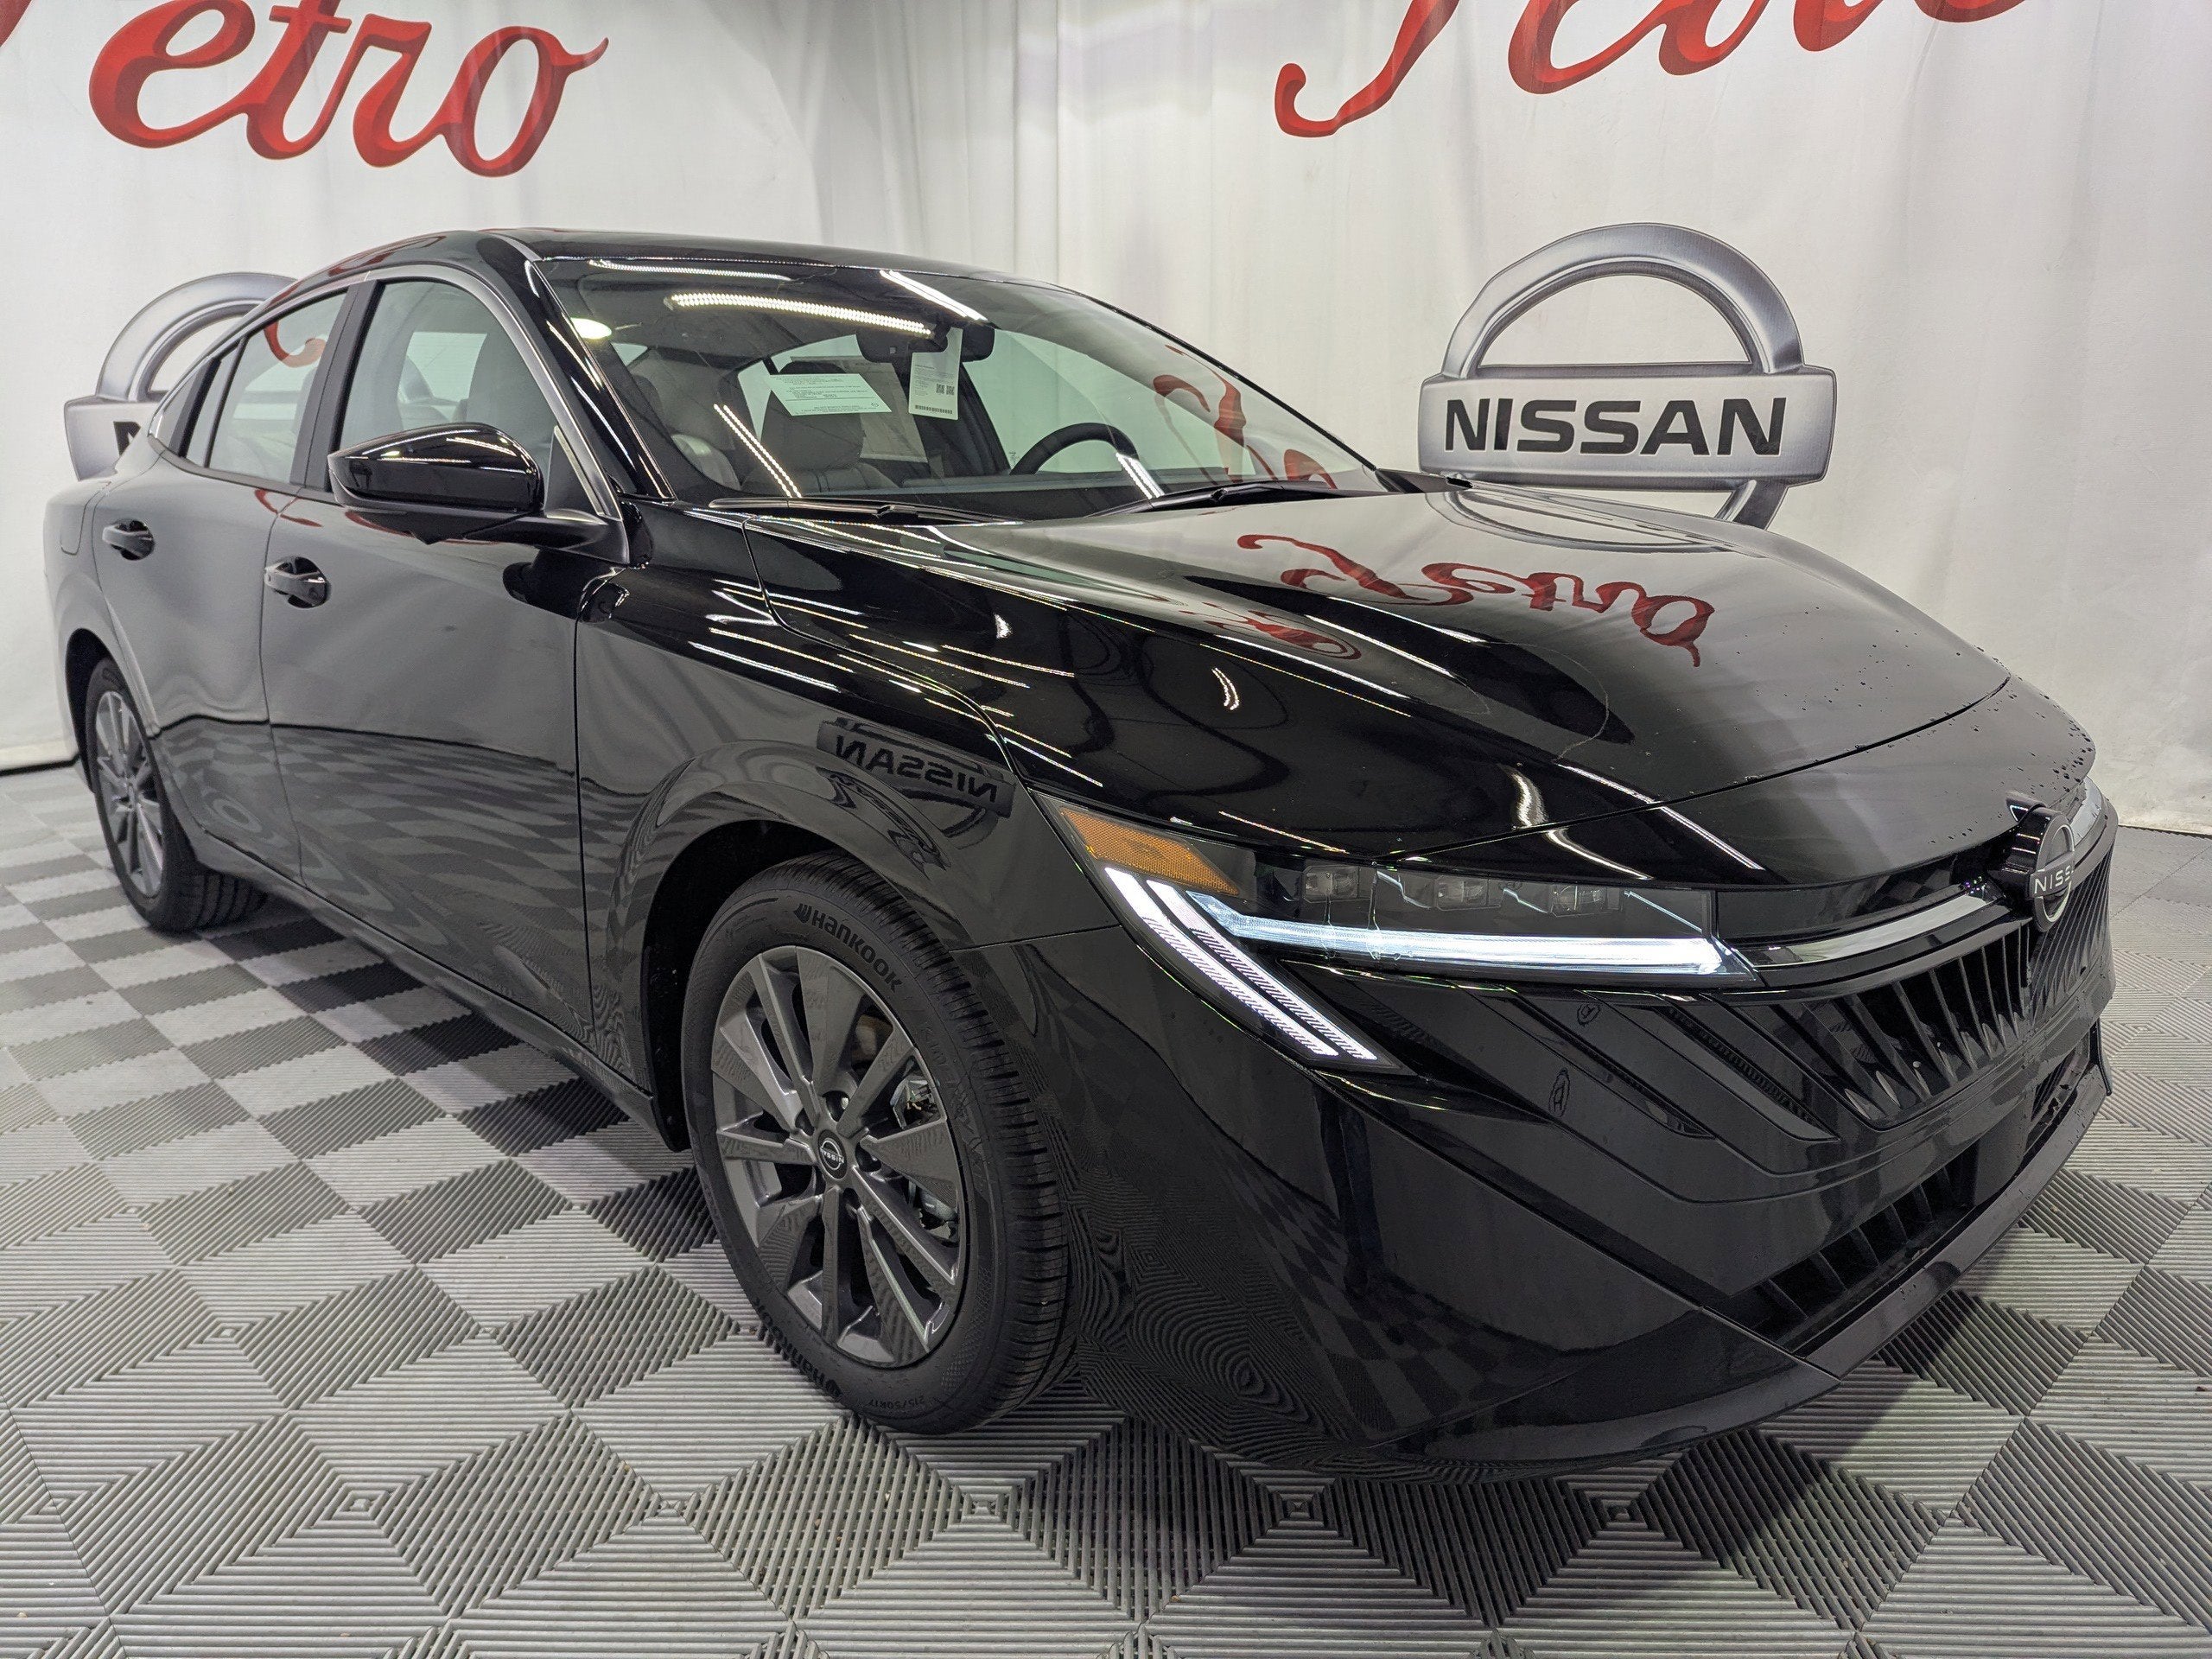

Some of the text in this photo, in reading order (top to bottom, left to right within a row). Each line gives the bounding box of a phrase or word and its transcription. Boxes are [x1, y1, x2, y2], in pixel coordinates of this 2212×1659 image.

[0, 0, 609, 177] etro
[1445, 397, 1787, 456] NISSAN
[2034, 865, 2075, 894] NISS
